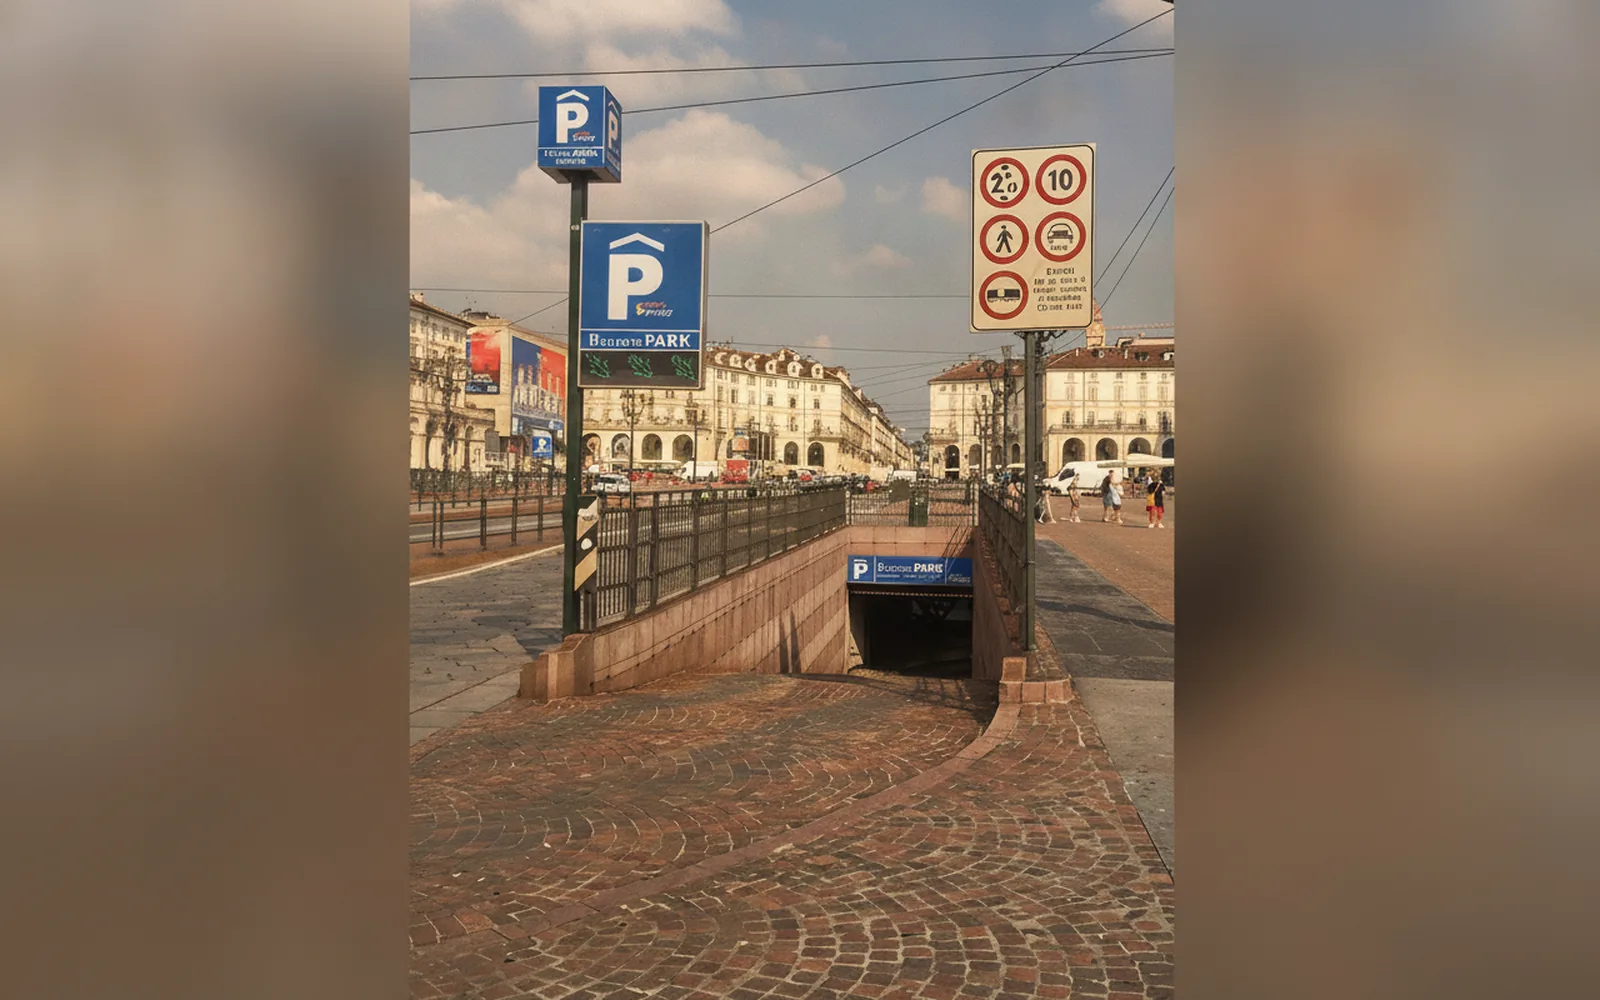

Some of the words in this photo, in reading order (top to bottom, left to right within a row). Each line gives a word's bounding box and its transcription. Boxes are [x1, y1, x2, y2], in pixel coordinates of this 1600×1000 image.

[556, 102, 589, 144] P
[1047, 168, 1073, 191] 10
[607, 253, 664, 320] P
[645, 334, 691, 348] PARK
[853, 562, 869, 580] P
